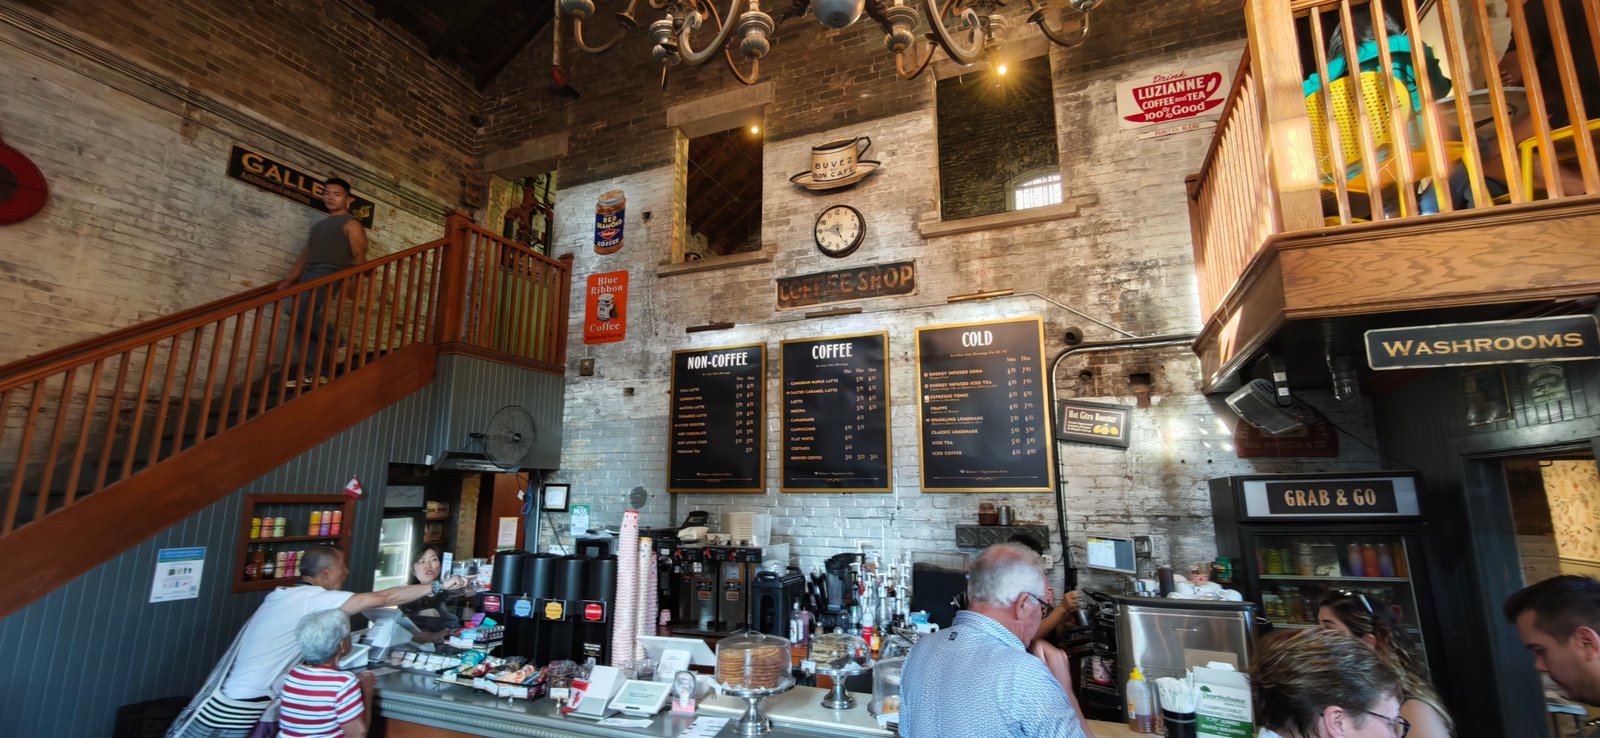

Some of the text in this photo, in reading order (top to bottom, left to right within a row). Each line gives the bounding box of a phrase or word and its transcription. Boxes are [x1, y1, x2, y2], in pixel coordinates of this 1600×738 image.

[1153, 71, 1188, 84] Drink
[1138, 77, 1205, 100] LUZIANNE
[1142, 91, 1206, 110] COFFEE and TEA
[1144, 102, 1205, 121] 100% Good
[815, 157, 852, 169] BUVEZ
[241, 152, 355, 209] GALLE
[597, 219, 623, 230] DIAMOND
[603, 215, 617, 223] RED
[597, 238, 620, 247] COFFEE
[598, 277, 619, 285] Blue
[779, 265, 913, 301] COFFEE SHOP
[591, 285, 623, 295] Ribbon
[589, 322, 621, 333] Coffee
[962, 330, 993, 347] COLD
[1382, 333, 1584, 357] WASHROOMS
[812, 343, 853, 360] COFFEE
[687, 352, 748, 370] NON-COFFEE
[1068, 409, 1118, 423] Hot Citro Booster
[1284, 488, 1377, 507] GRAB & GO
[1201, 723, 1219, 731] PAPER
[1218, 727, 1247, 735] WRAPPED
